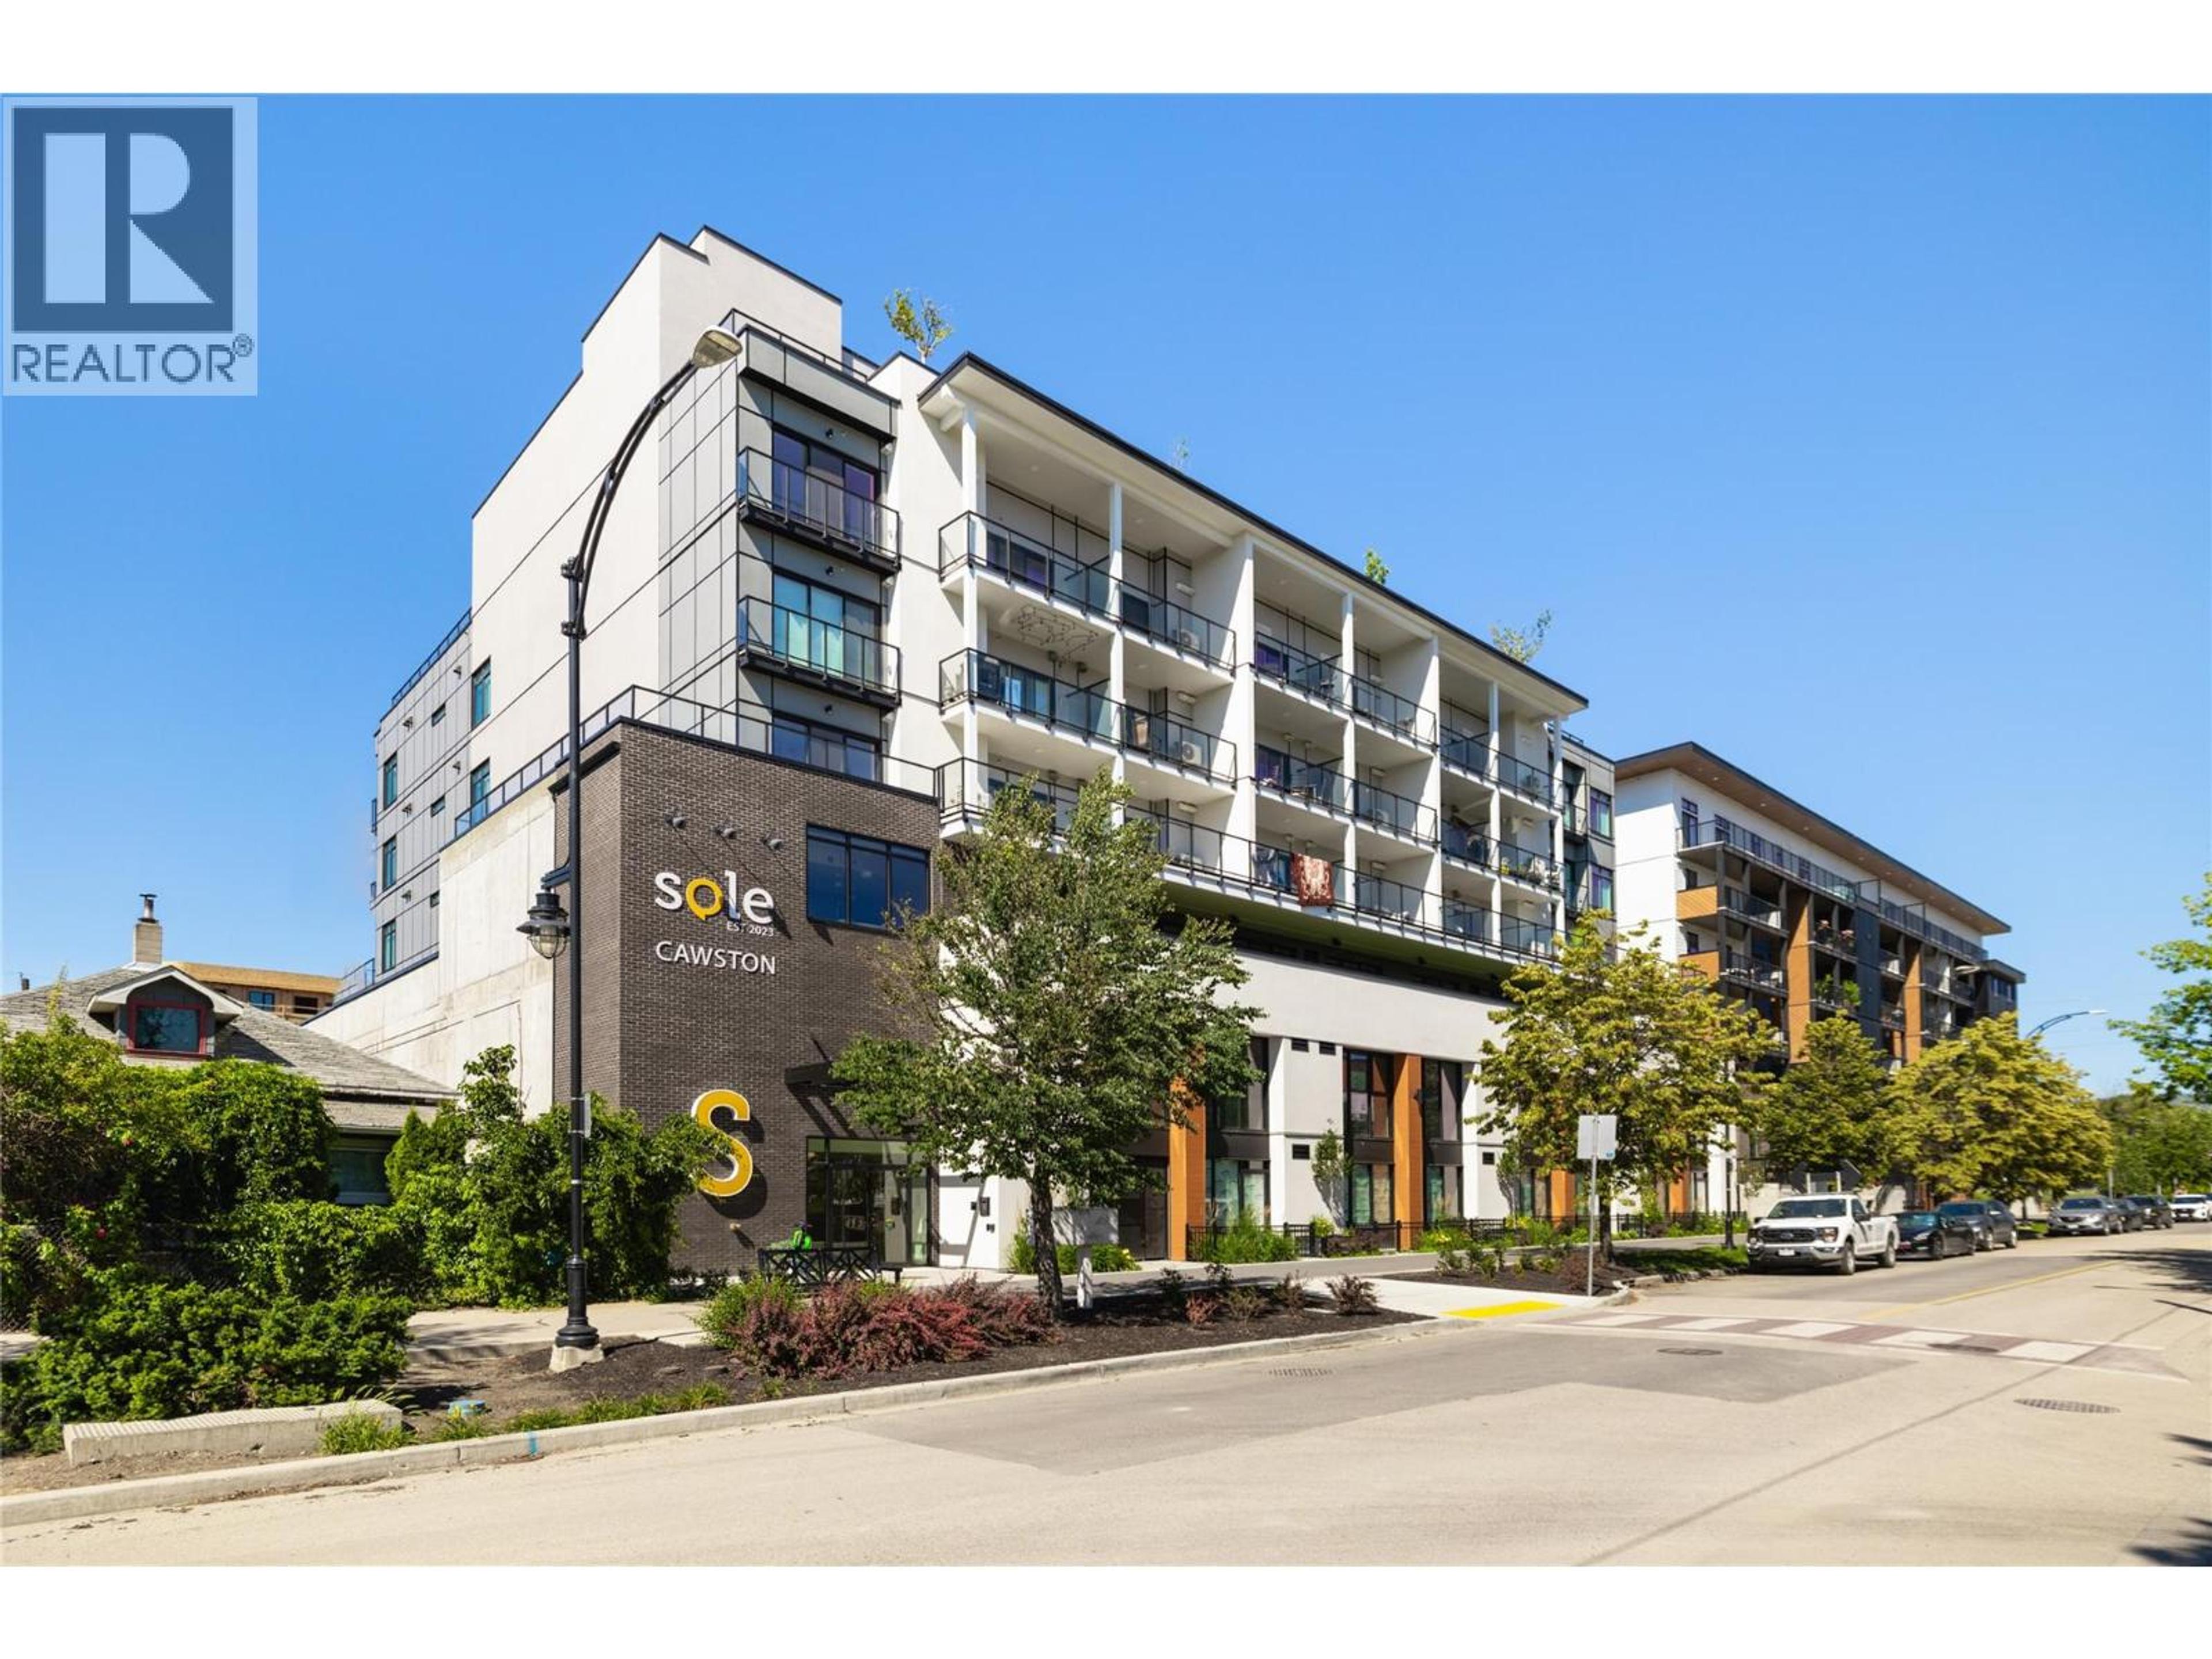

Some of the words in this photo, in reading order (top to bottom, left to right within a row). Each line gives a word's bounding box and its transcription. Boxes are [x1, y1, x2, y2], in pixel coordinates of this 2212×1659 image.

[654, 870, 774, 923] sole
[749, 924, 774, 937] 2023
[656, 940, 775, 975] CAWSTON
[691, 1089, 753, 1197] S
